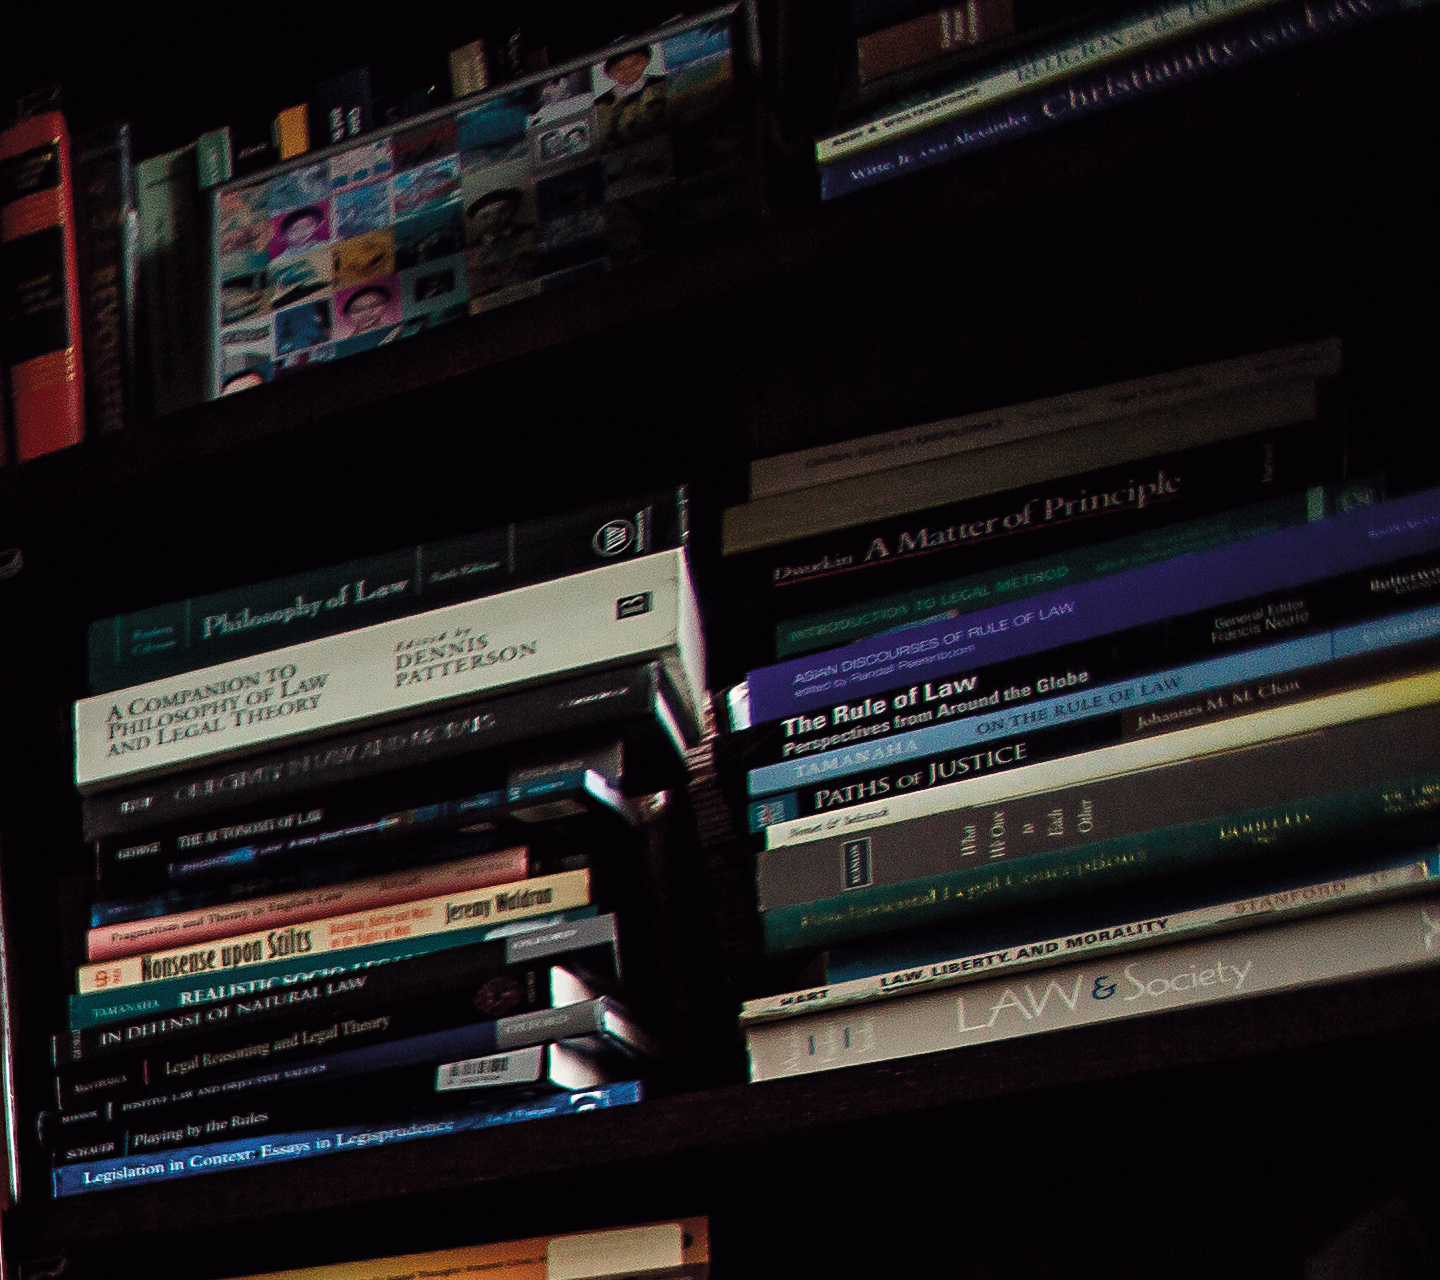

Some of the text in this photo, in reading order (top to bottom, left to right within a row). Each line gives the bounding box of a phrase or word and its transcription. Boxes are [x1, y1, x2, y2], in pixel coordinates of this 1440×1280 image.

[864, 470, 1182, 561] A Matter of Principle
[202, 577, 409, 640] Philosophy of Law
[395, 632, 490, 669] DENNIS
[395, 640, 538, 689] PATTERSON
[107, 704, 124, 722] A
[266, 664, 297, 683] TO
[245, 688, 274, 708] OF
[782, 674, 978, 740] The Rule of Law
[782, 668, 1089, 757] Perspectives from Around the Globe
[107, 735, 151, 757] AND
[814, 743, 1028, 810] PATHS OF JUSTICE
[444, 884, 553, 925] Jeremy Waldron
[140, 926, 312, 982] Nonsense upon Stilts
[1016, 942, 1060, 960] AND
[1065, 918, 1170, 949] MORALITY
[955, 959, 1254, 1035] LAW & Society
[83, 1160, 165, 1186] Legislation
[169, 1156, 185, 1172] in
[260, 1139, 311, 1165] Essays
[315, 1132, 333, 1150] in
[336, 1116, 456, 1150] Legisprudence
[132, 1109, 269, 1152] Playing by the Rules
